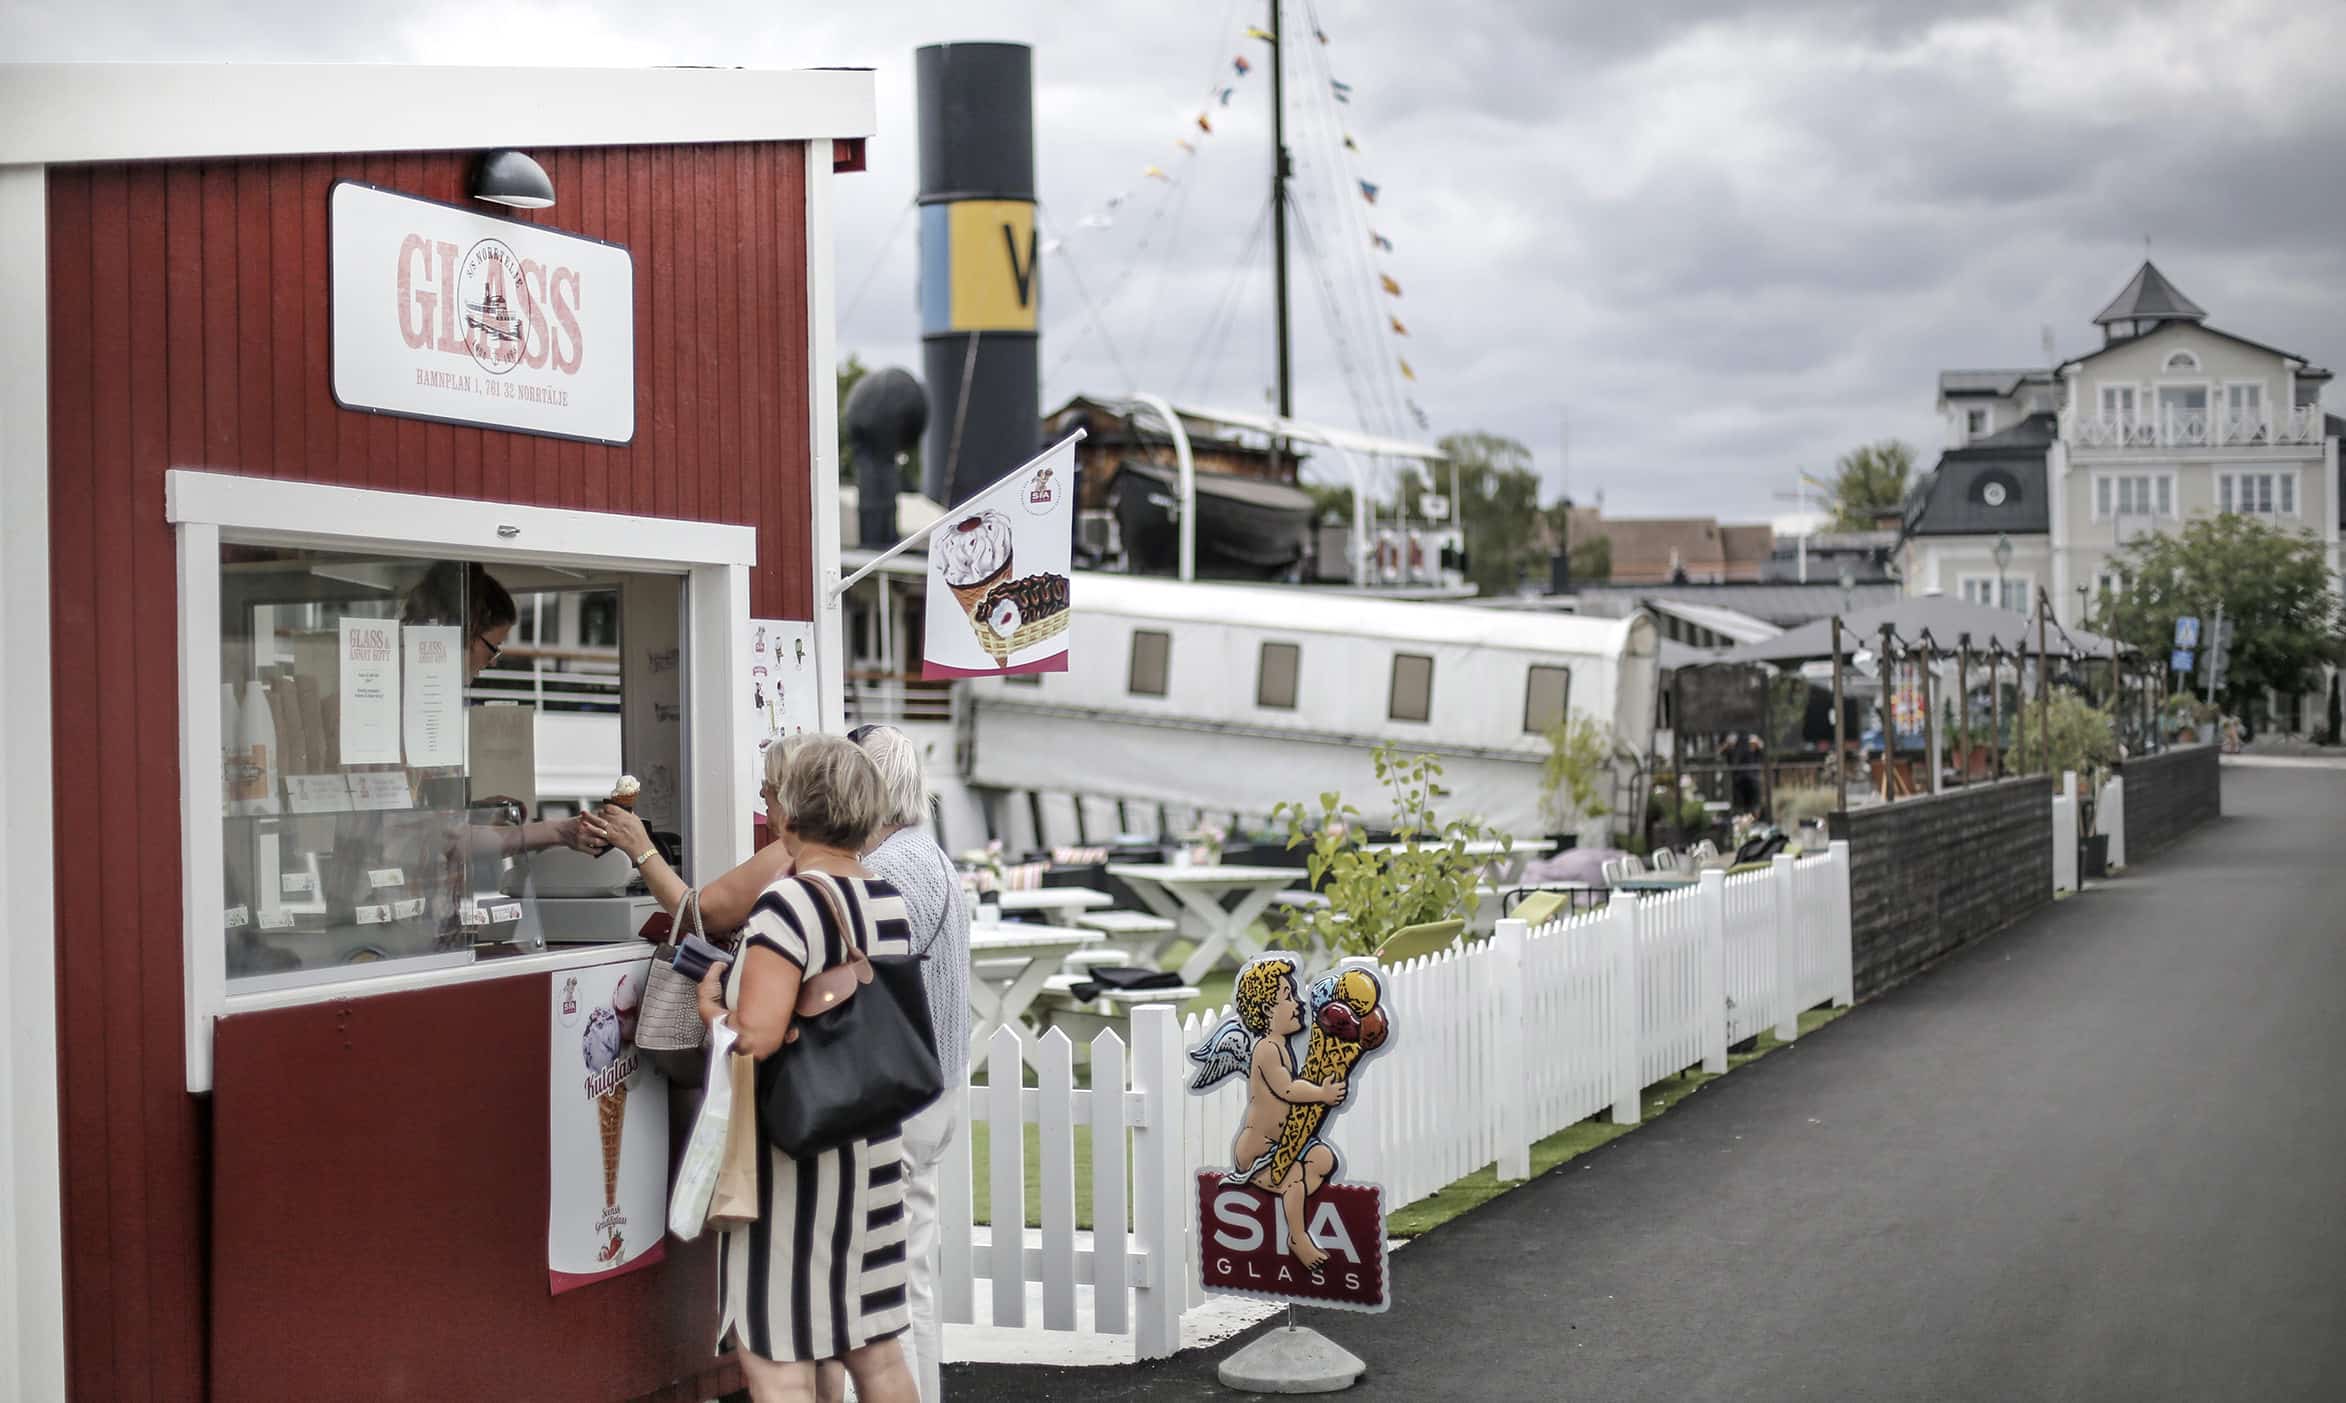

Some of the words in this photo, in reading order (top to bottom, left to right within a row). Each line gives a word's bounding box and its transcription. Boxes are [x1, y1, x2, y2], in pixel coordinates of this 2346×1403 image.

[397, 233, 583, 375] GLASS
[416, 368, 471, 392] HAMNPLAN
[518, 384, 569, 407] NORRTÄLJE
[584, 1056, 639, 1100] Kulglass
[1213, 1190, 1361, 1264] SIA
[1216, 1257, 1360, 1290] GLASS
